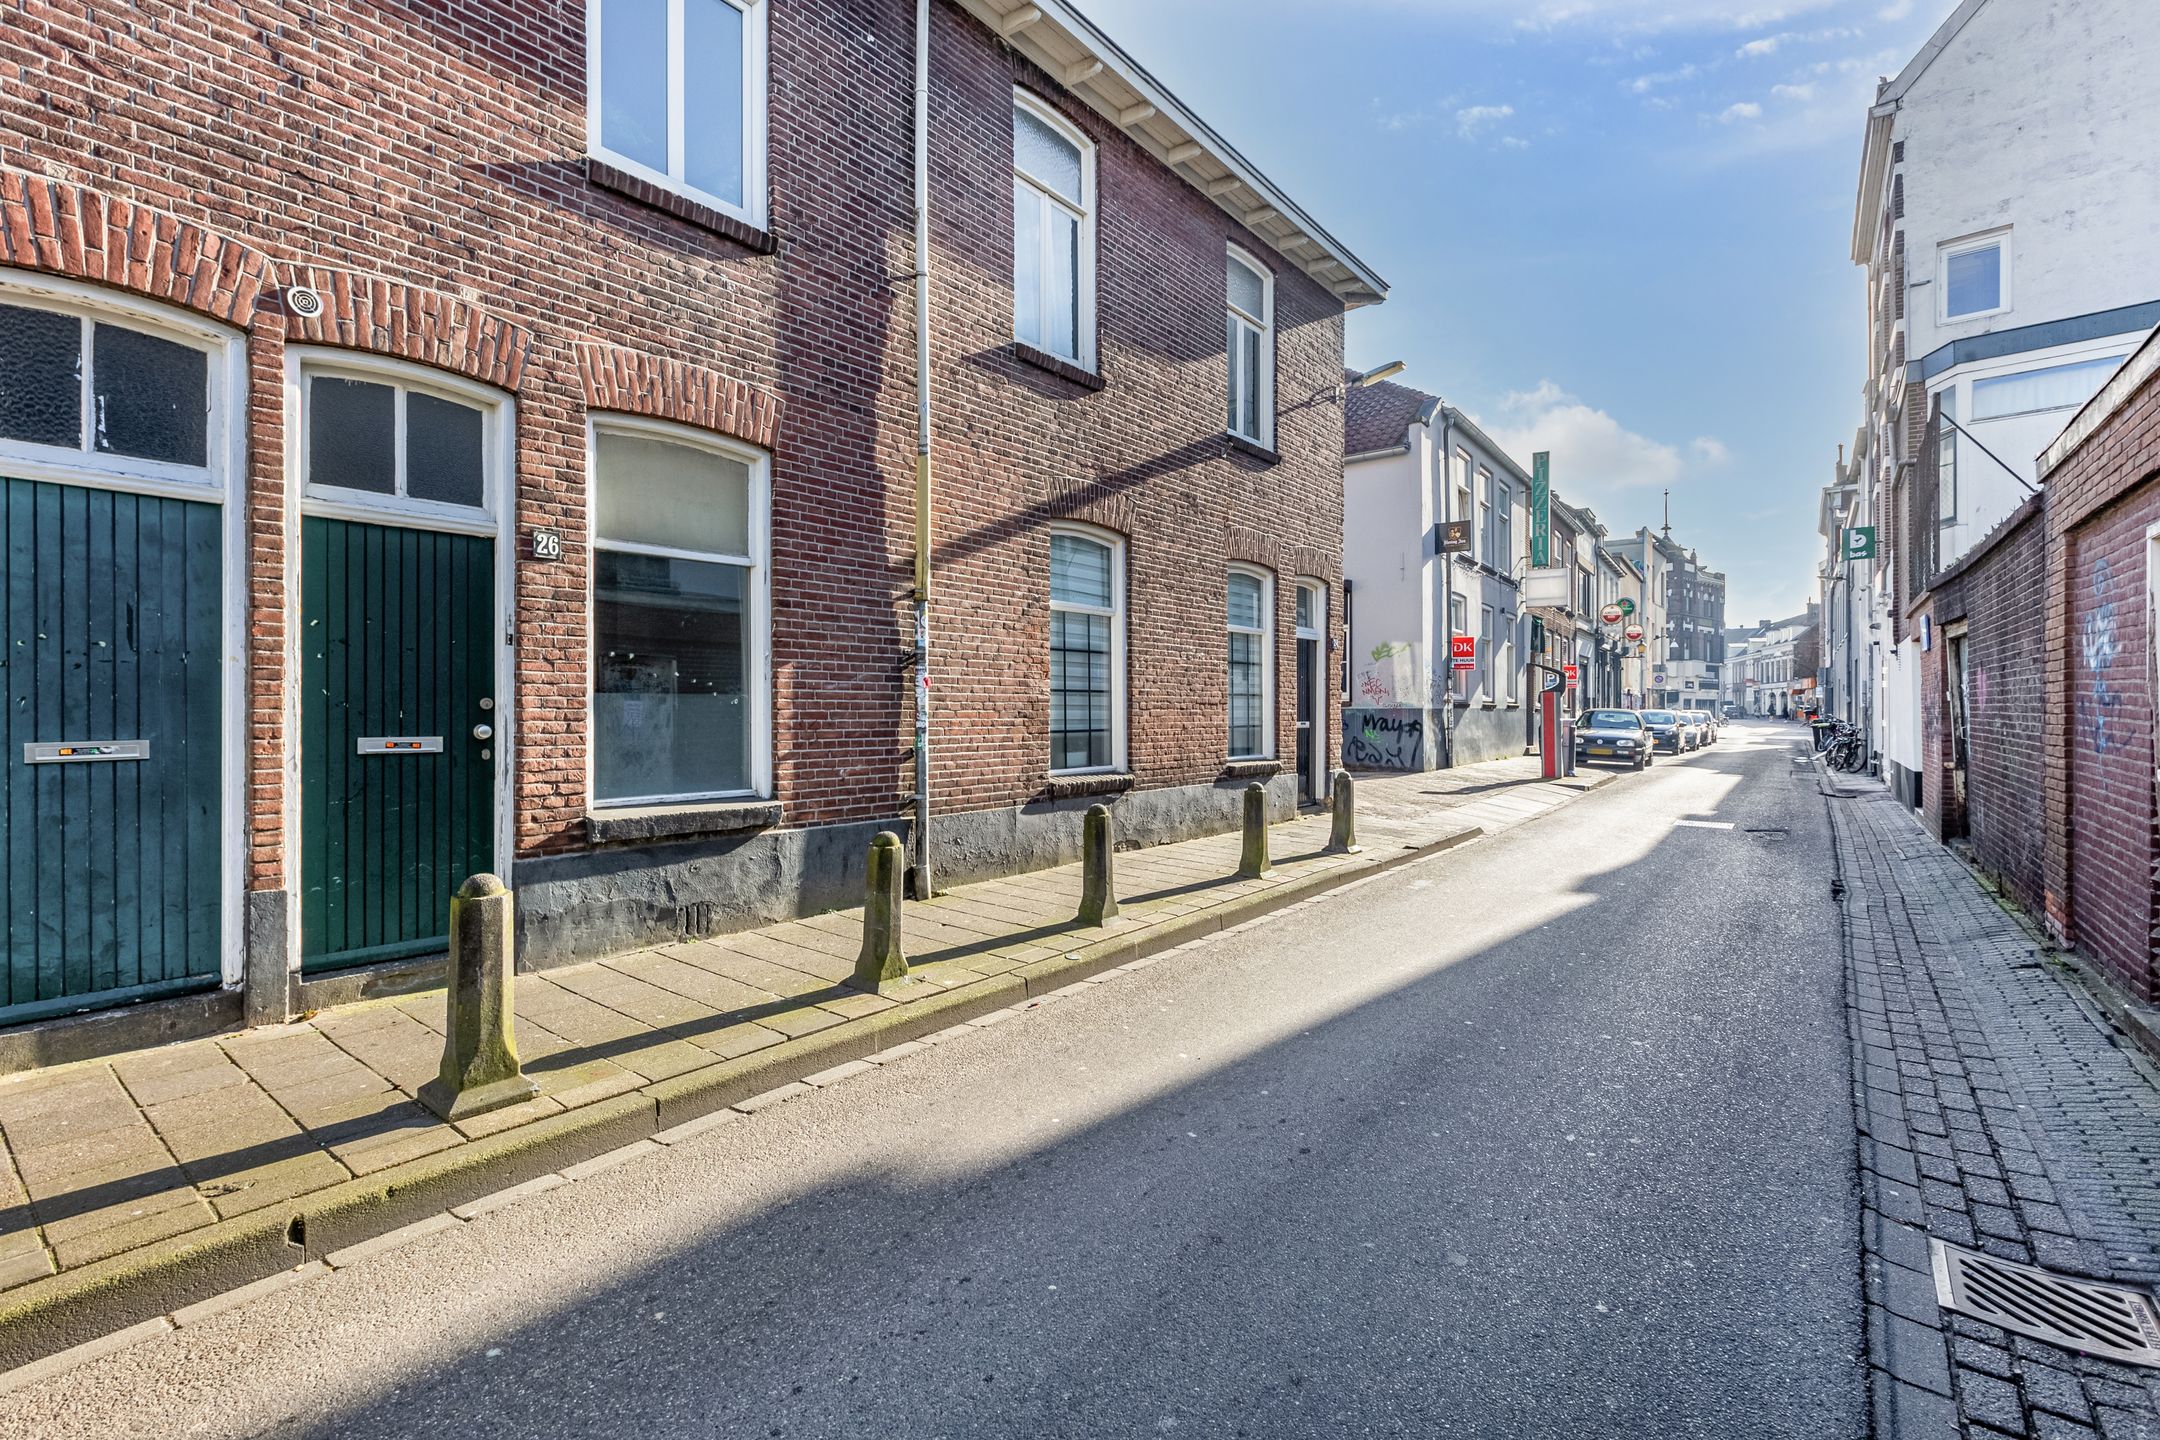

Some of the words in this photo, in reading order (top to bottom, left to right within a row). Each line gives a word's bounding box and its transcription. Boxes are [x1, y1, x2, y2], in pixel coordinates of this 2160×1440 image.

[1535, 454, 1547, 565] PIZZERIA
[536, 534, 559, 555] 26
[1453, 642, 1473, 652] DK
